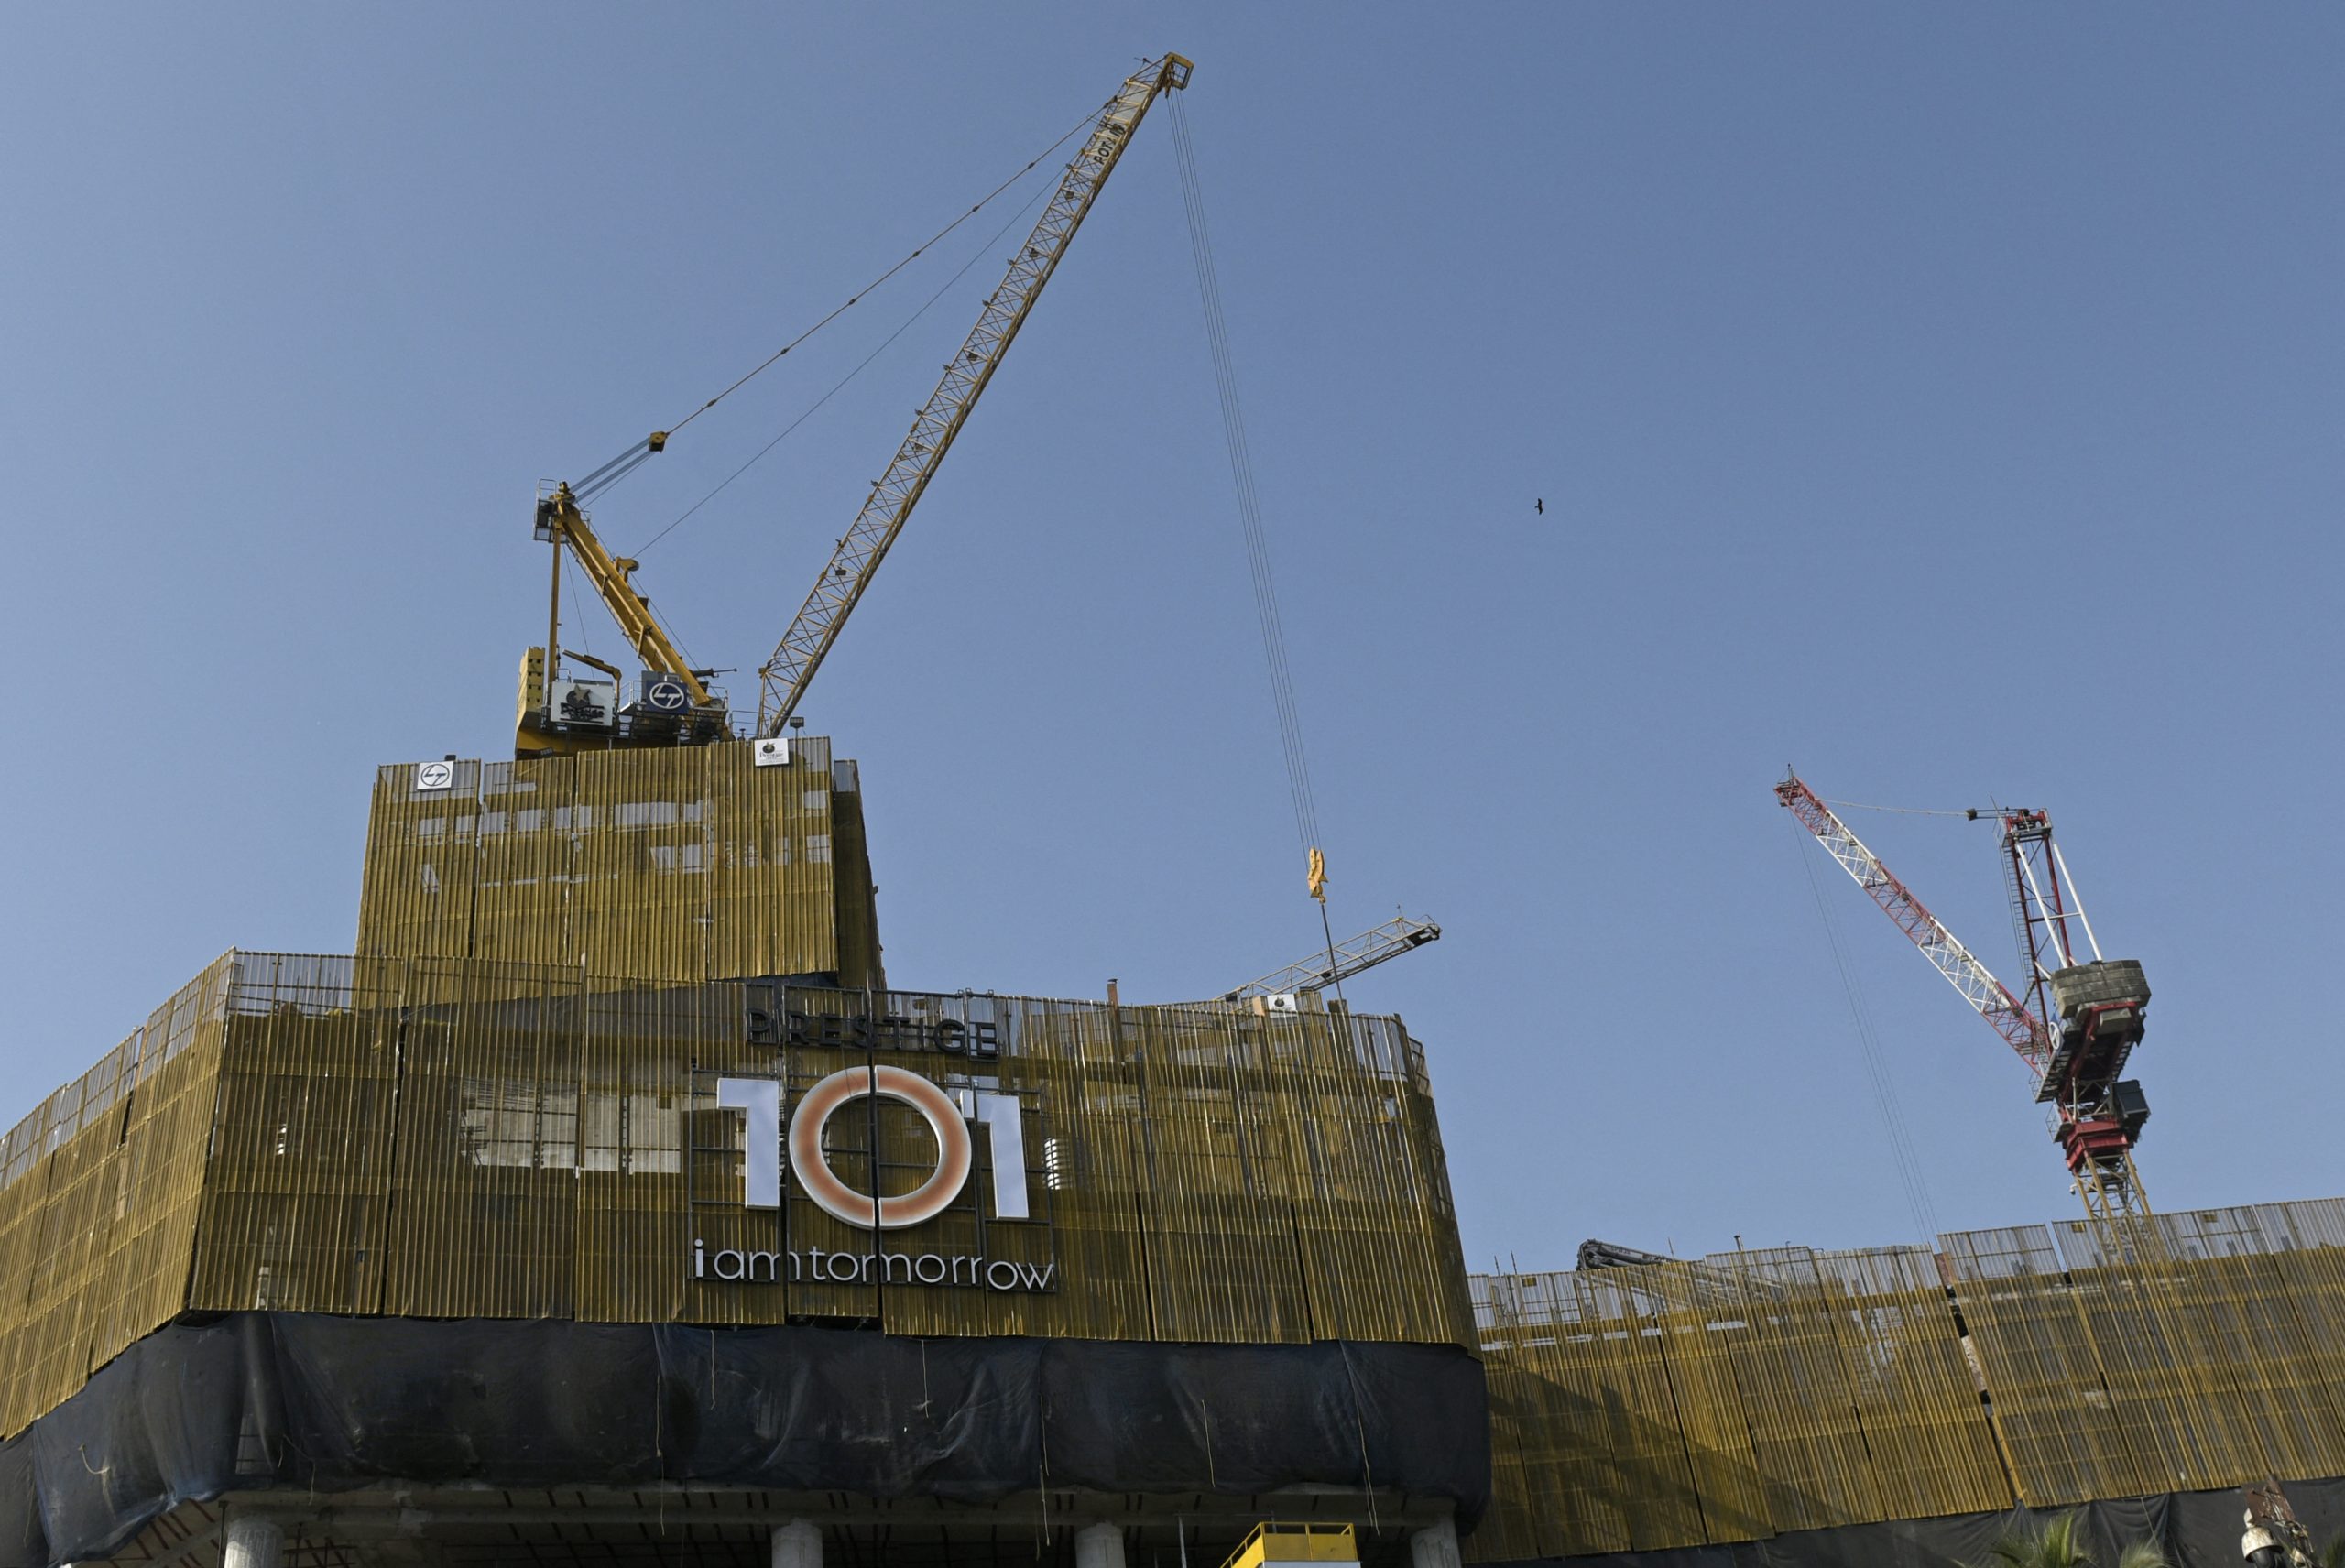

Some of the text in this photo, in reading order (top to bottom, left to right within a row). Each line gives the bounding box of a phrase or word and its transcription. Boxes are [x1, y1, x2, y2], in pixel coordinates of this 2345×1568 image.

[747, 1008, 998, 1055] PRESTIGE
[717, 1065, 1029, 1229] 101
[694, 1239, 1053, 1290] i am tomorrow
